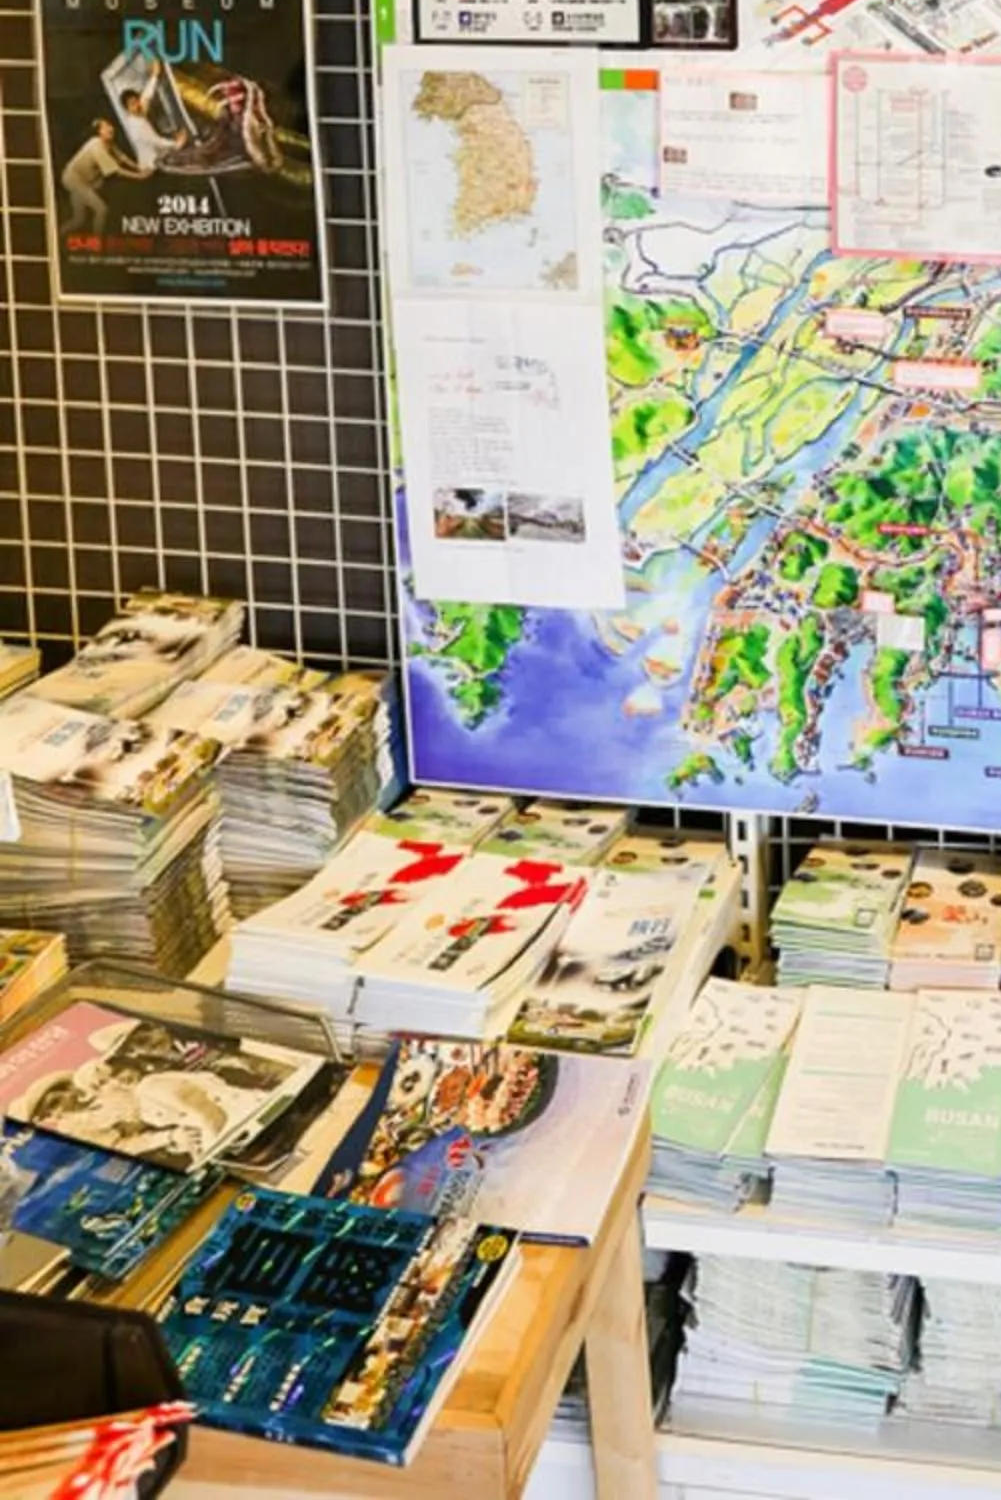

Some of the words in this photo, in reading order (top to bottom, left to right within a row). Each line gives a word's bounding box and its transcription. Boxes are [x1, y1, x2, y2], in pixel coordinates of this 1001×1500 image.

[123, 19, 224, 64] RUN
[158, 194, 210, 215] 2014
[123, 216, 160, 234] NEW
[164, 216, 251, 237] EXHIBITION
[924, 1106, 1001, 1130] BUSAN
